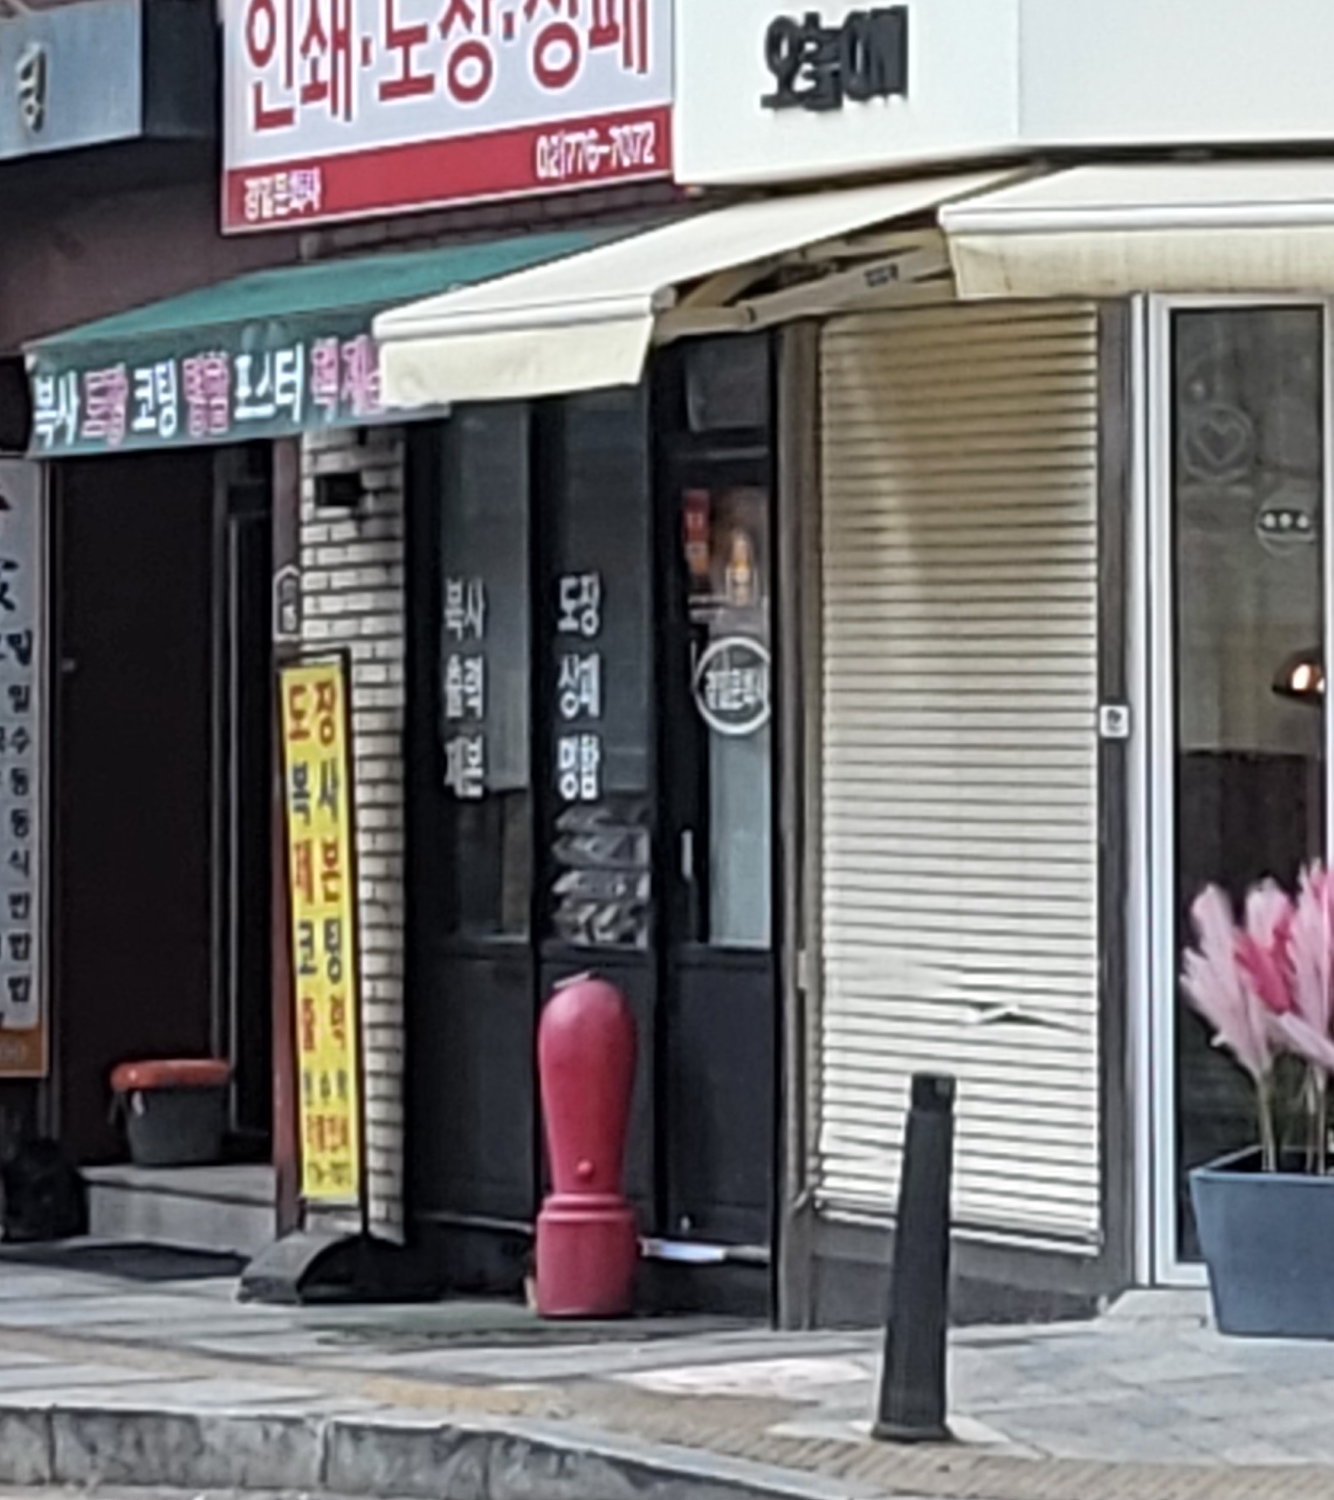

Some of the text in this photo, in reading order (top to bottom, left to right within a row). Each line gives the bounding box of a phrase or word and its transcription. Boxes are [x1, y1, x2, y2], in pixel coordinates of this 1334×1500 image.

[132, 357, 178, 438] 코팅
[234, 342, 304, 423] 포스터
[557, 570, 601, 637] 도장
[288, 680, 338, 747] 도장
